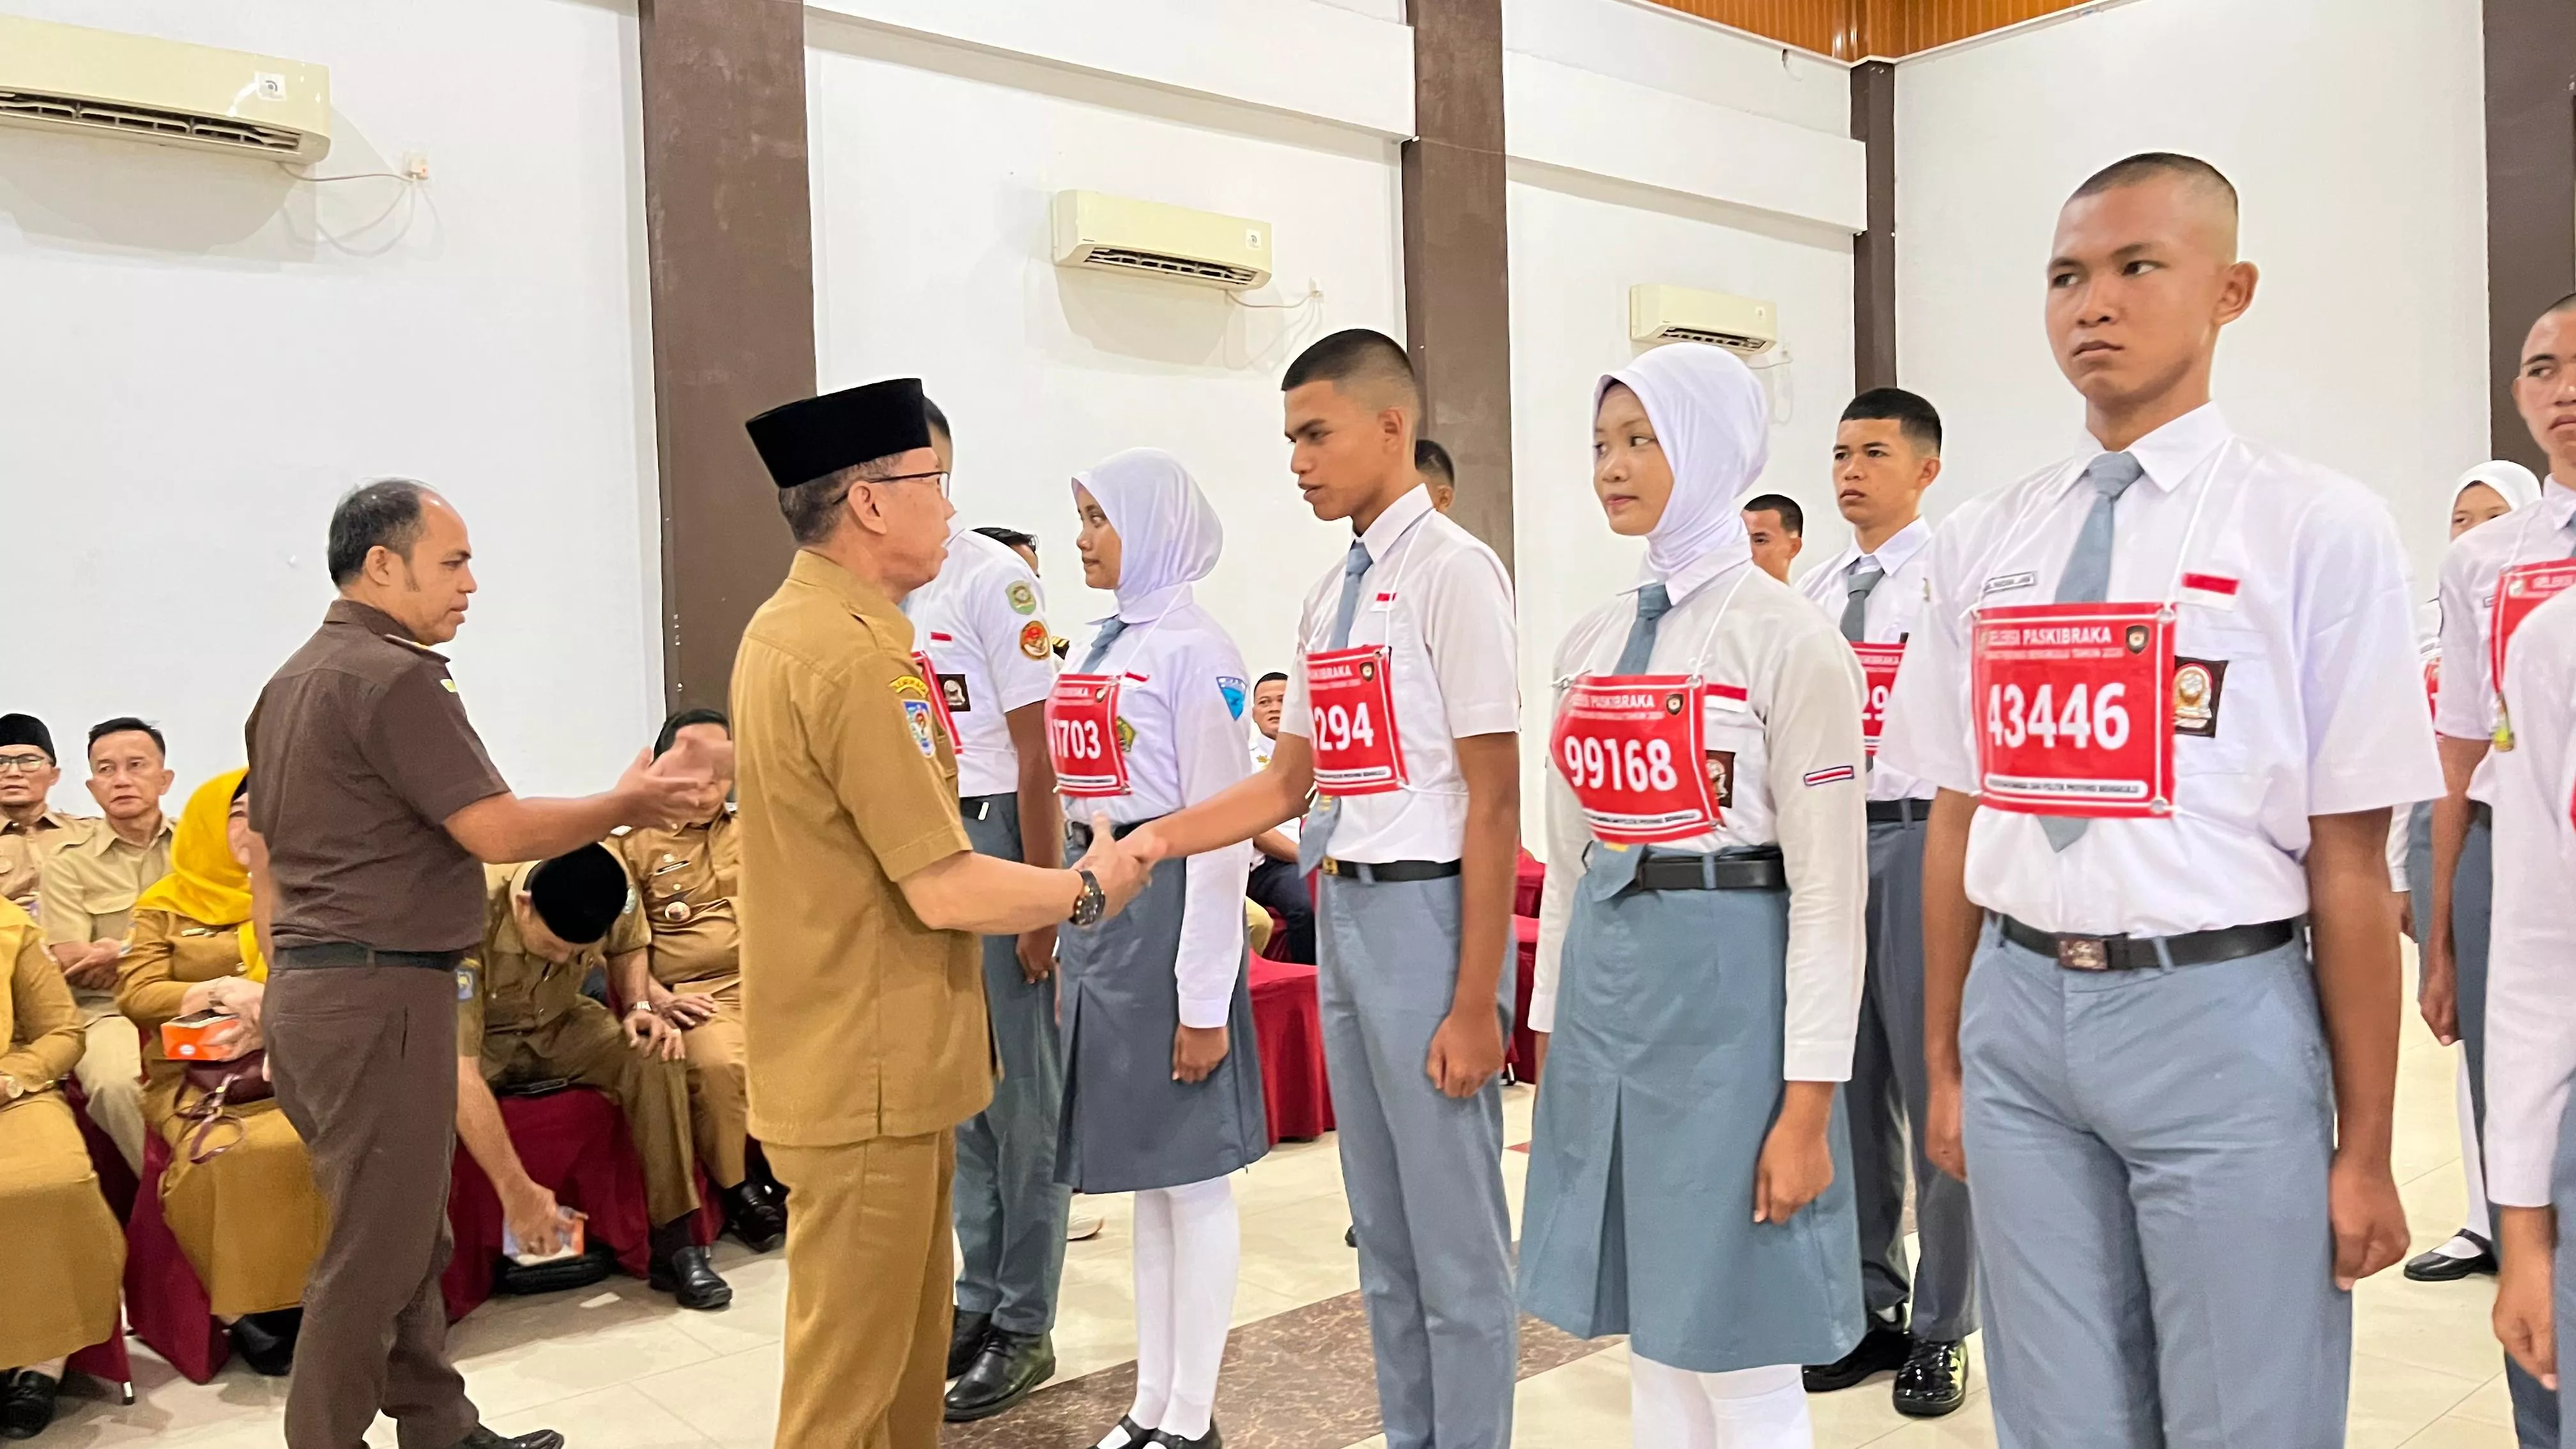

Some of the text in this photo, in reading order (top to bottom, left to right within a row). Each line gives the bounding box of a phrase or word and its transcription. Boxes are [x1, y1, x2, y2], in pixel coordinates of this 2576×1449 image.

[2022, 626, 2112, 646] PASKIBRAKA
[1311, 702, 1375, 751] 294
[1987, 682, 2131, 751] 43446
[1564, 735, 1678, 793] 99168
